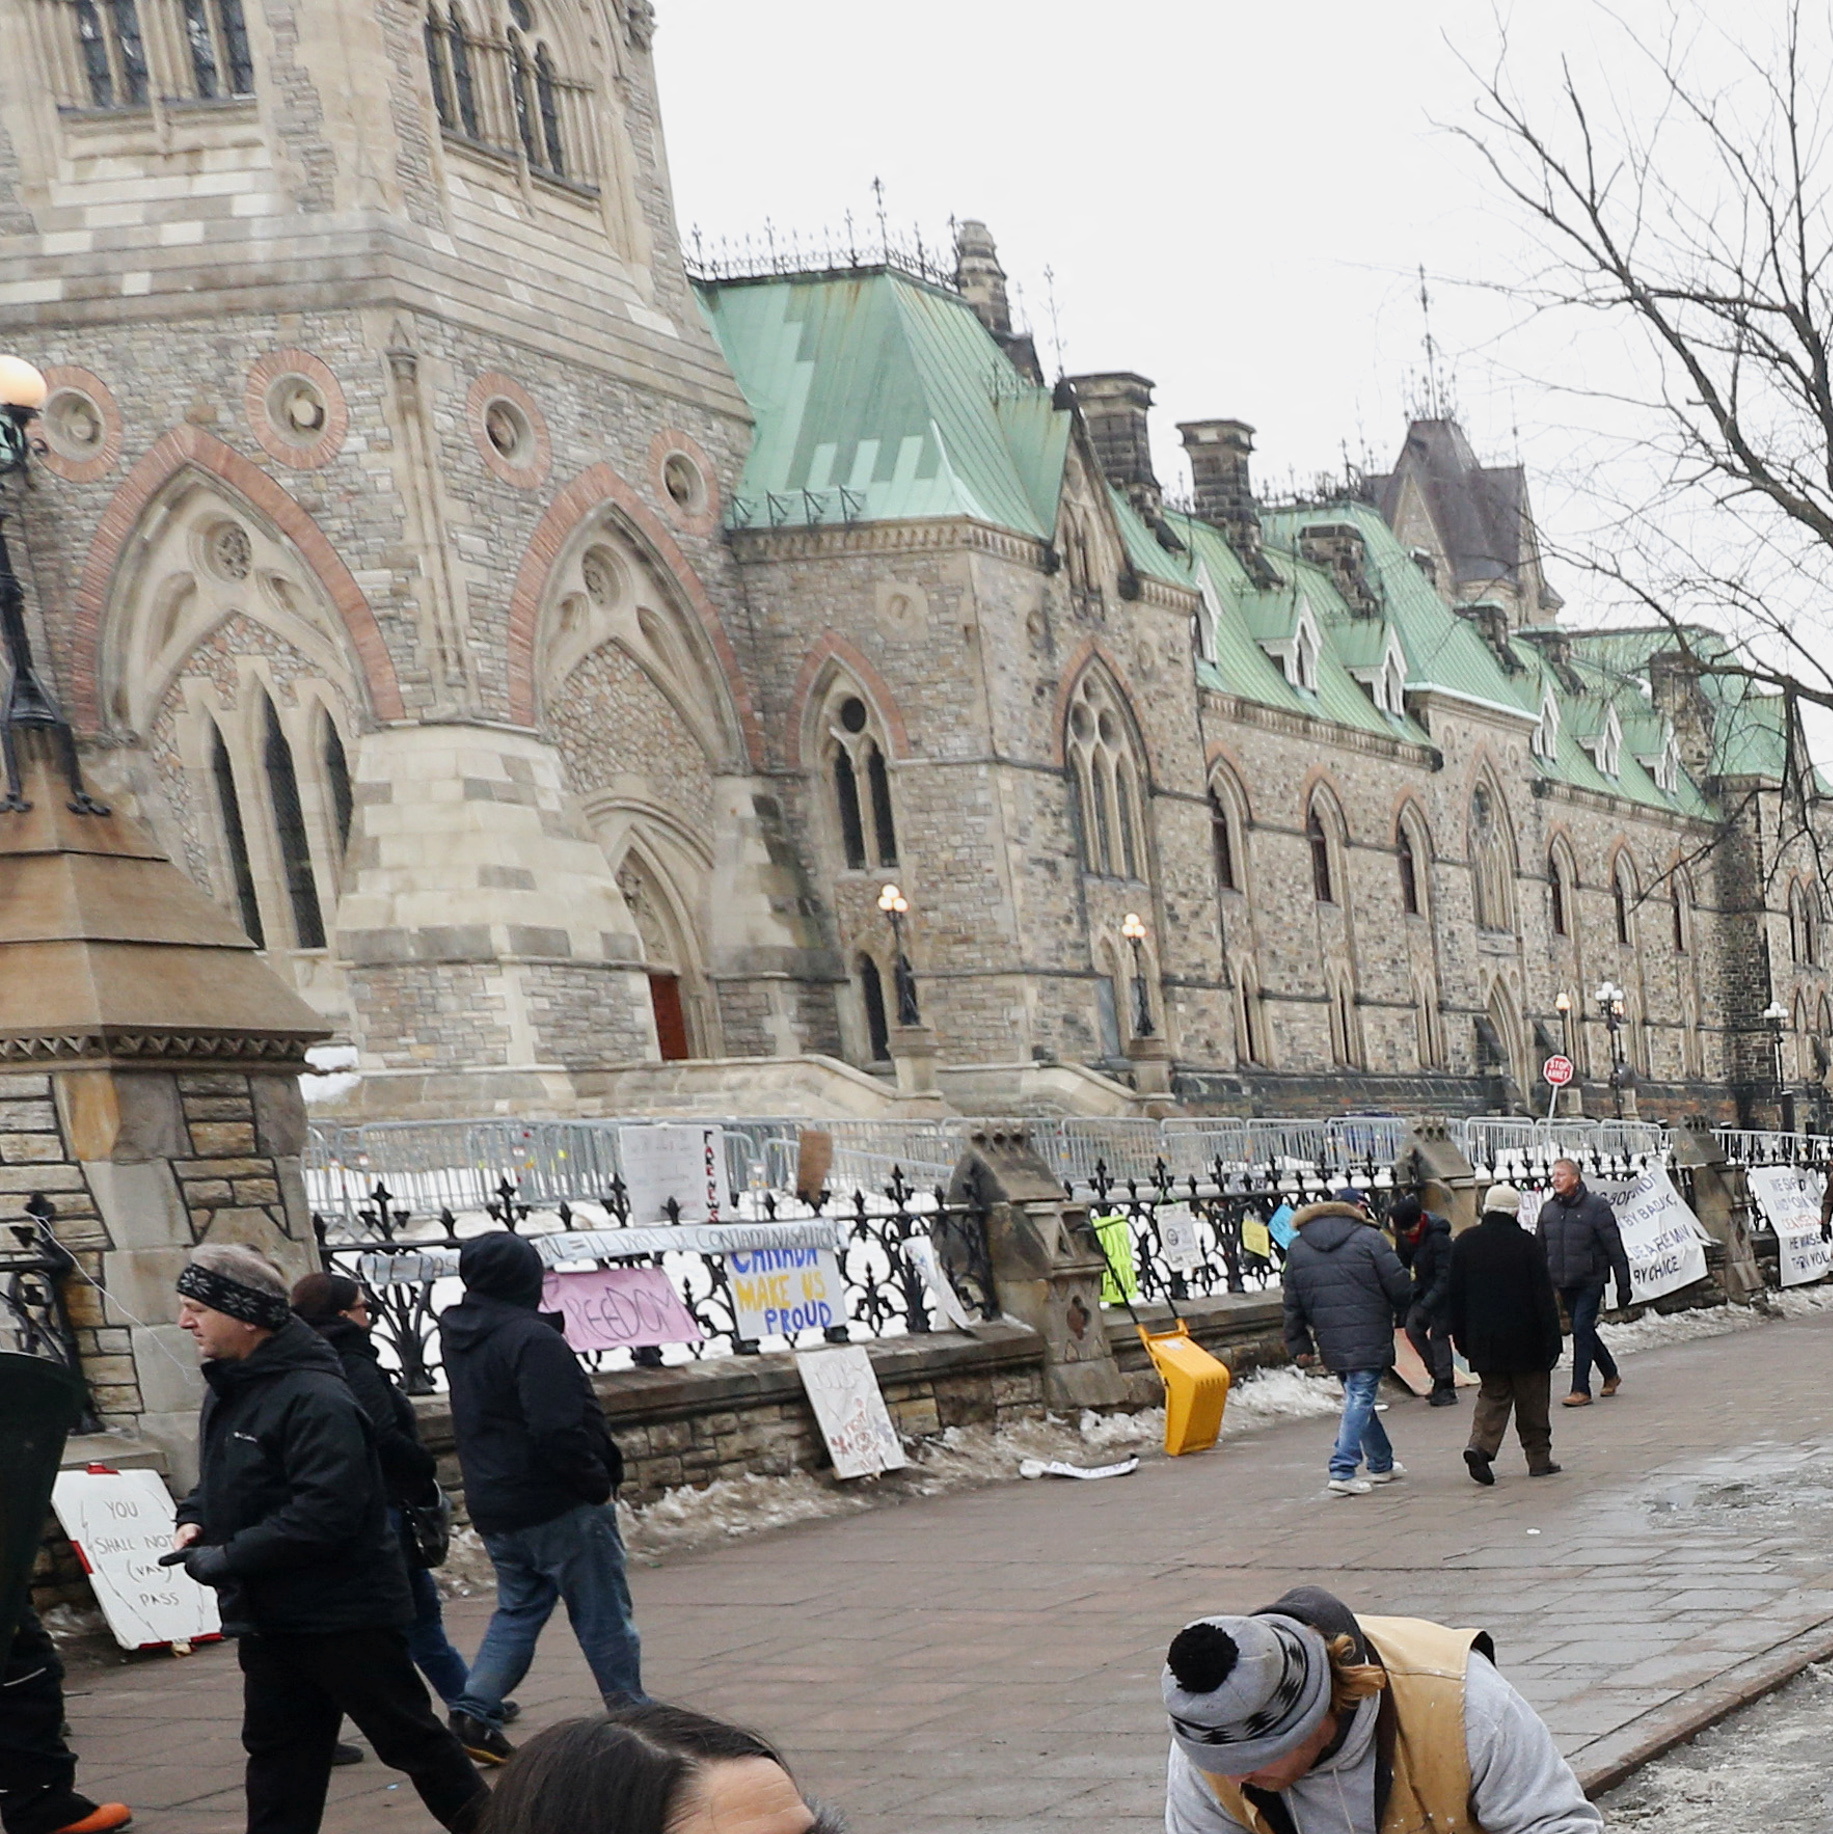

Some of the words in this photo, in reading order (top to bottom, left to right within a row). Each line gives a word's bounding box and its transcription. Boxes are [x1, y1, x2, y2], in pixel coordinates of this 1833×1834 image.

[1549, 1059, 1569, 1070] STOP
[731, 1248, 818, 1274] CANADA
[734, 1274, 792, 1313] MAKE
[800, 1270, 827, 1301] US
[764, 1300, 832, 1335] PROUD
[103, 1500, 139, 1520] YOU
[95, 1536, 136, 1555] SHALL
[144, 1533, 173, 1549] NOT
[139, 1592, 180, 1608] PASS
